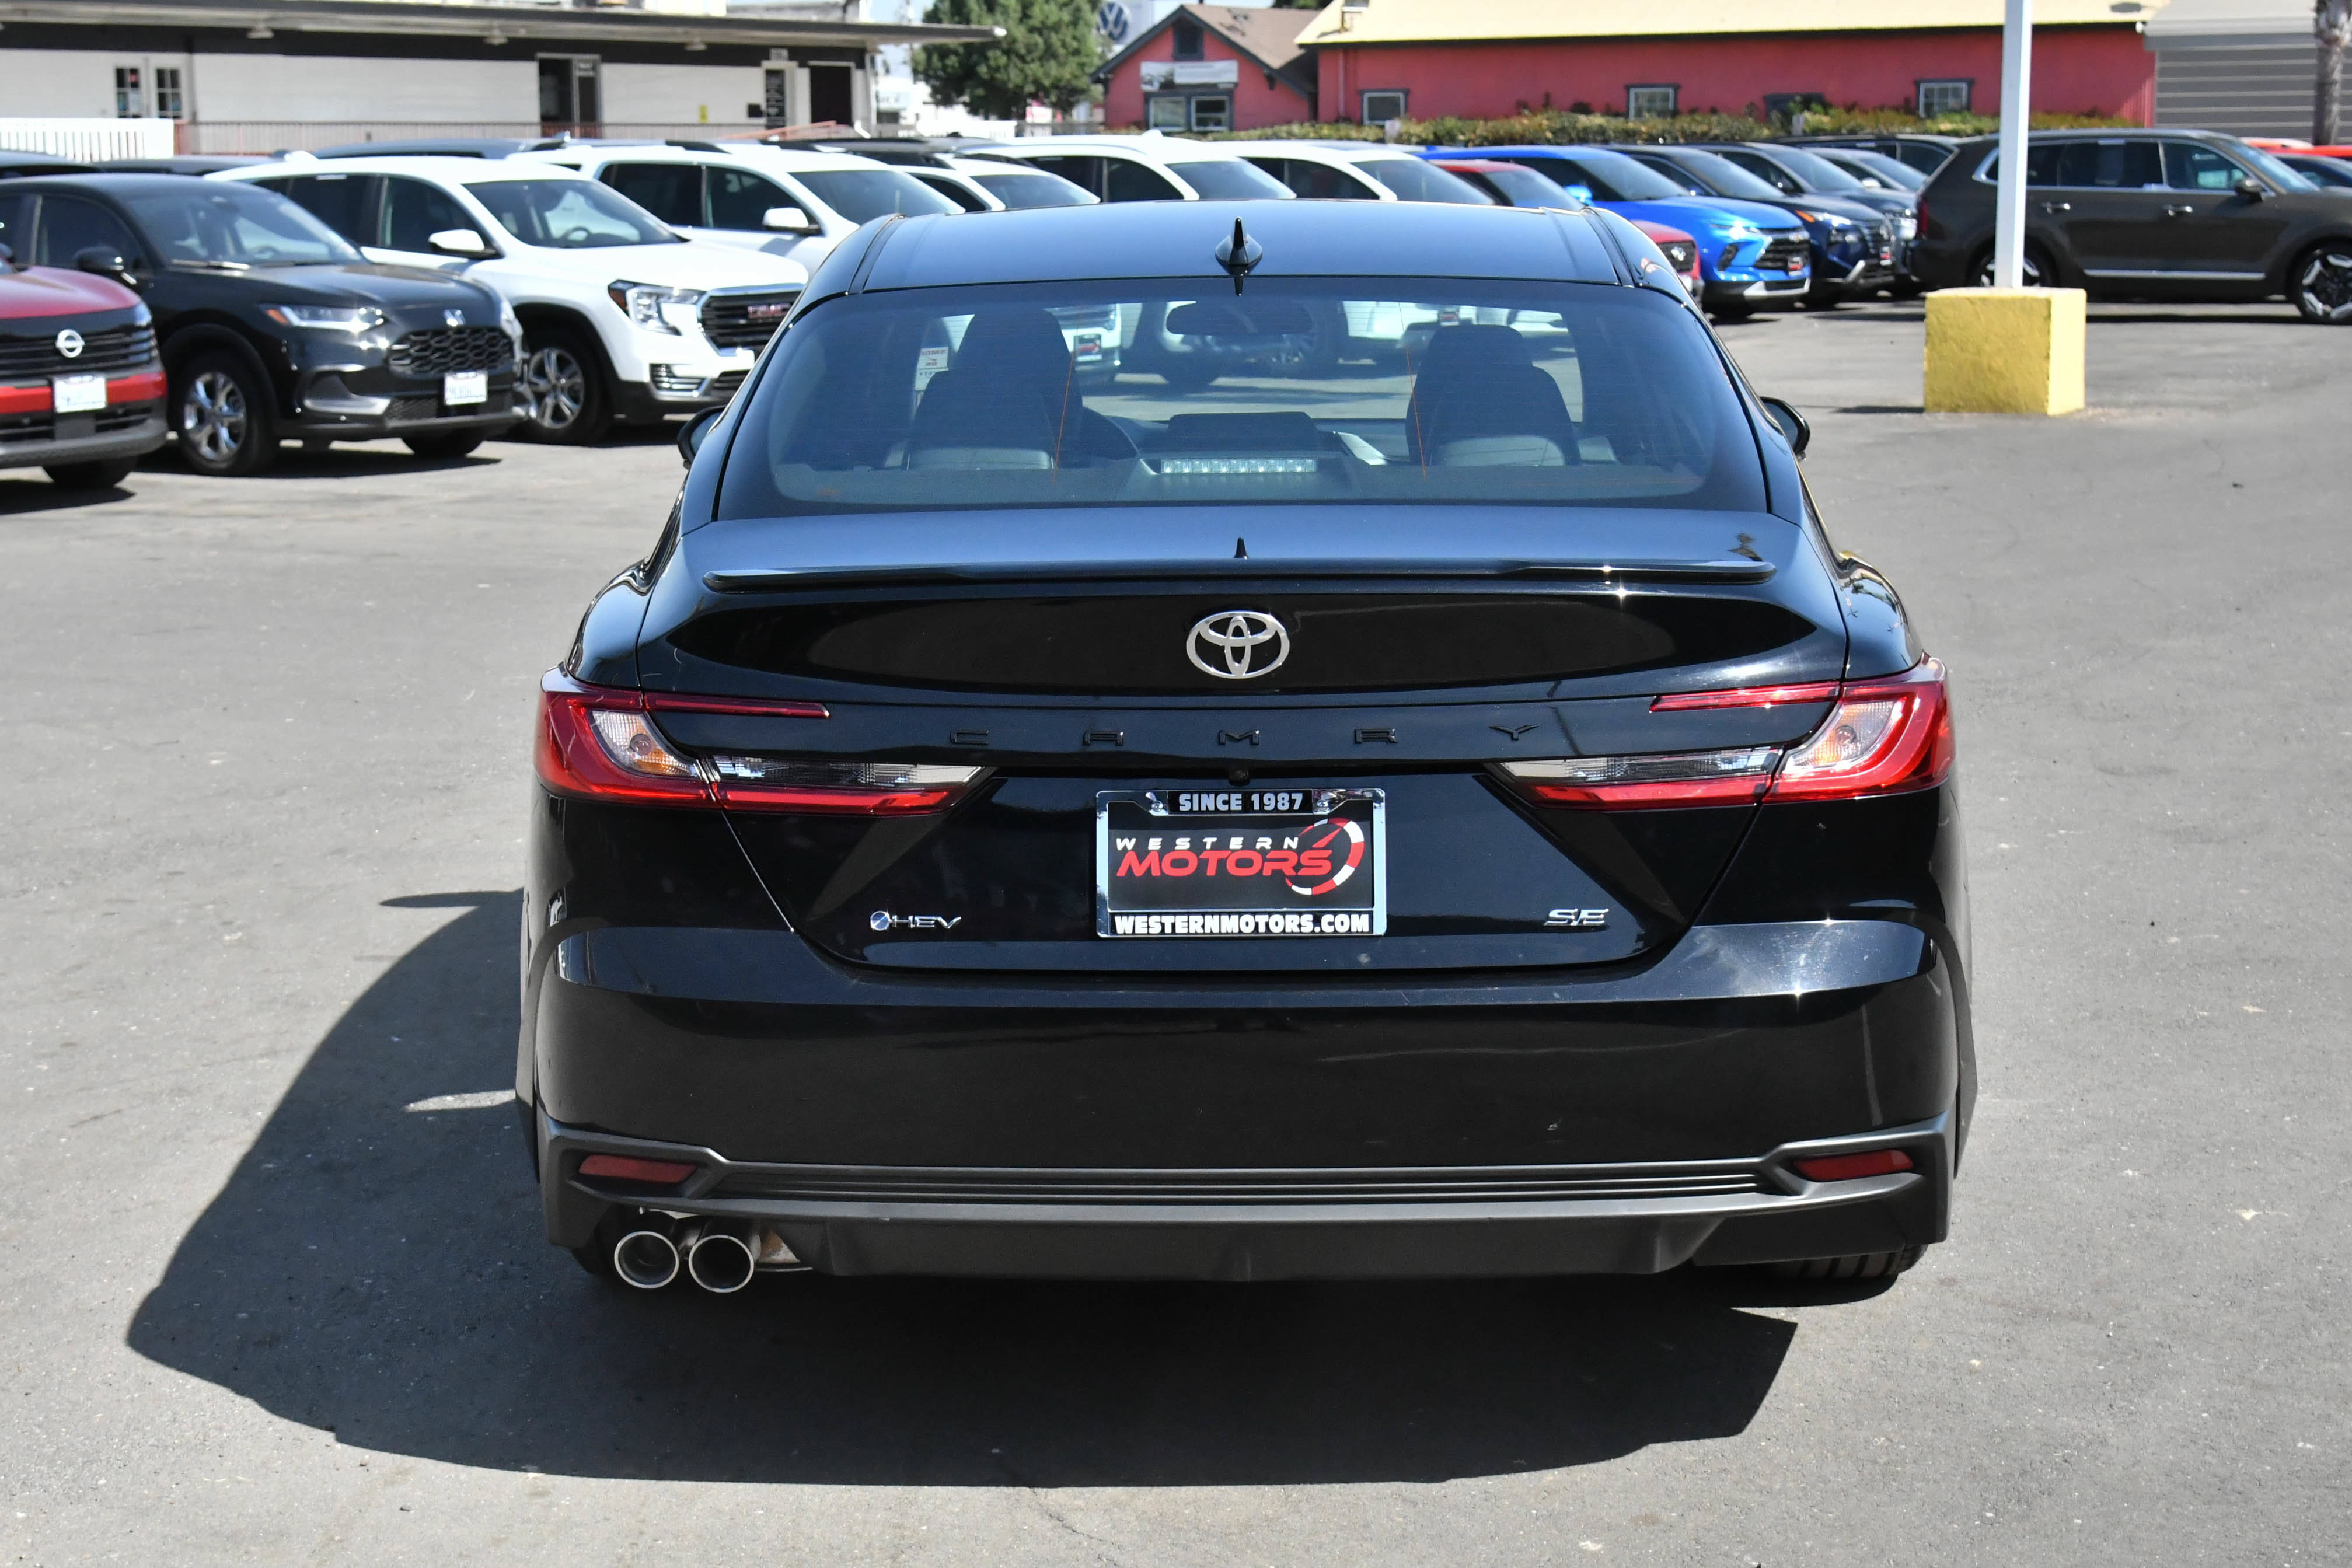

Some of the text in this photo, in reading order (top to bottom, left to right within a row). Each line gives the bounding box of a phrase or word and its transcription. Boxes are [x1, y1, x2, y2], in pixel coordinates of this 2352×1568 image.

[950, 724, 1540, 746] CAMRY
[1179, 792, 1303, 811] SINCE 1987
[1116, 837, 1299, 850] WESTERN
[1116, 850, 1332, 876] MOTORS
[891, 914, 962, 928] HEV
[1115, 914, 1370, 933] WESTERNMOTORS.COM
[1544, 908, 1609, 926] SE
